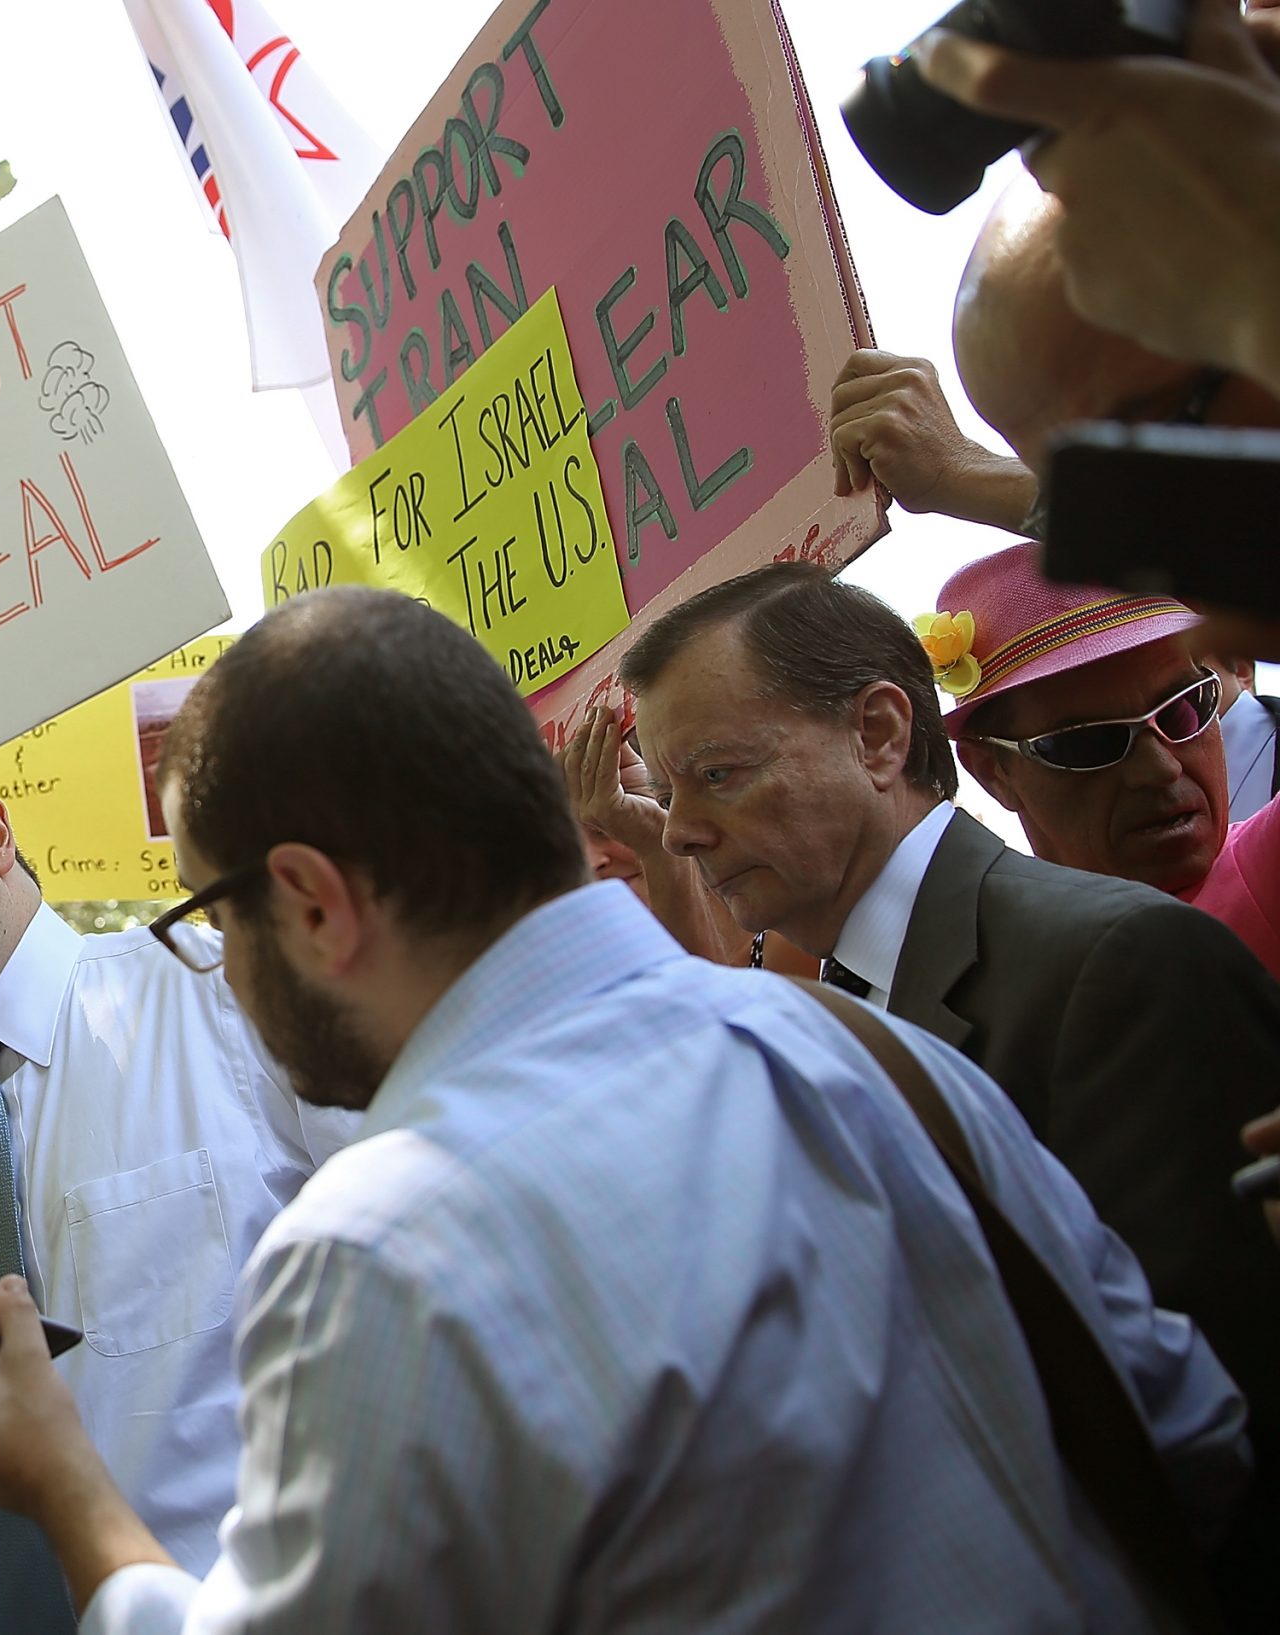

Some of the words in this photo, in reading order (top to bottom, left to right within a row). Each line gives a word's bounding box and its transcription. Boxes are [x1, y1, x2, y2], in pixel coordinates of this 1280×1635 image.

[327, 0, 565, 383] SUPPORT
[588, 132, 790, 437] EAR
[271, 540, 332, 606] BAD
[369, 467, 432, 565] FOR
[447, 536, 528, 639] THE
[533, 455, 607, 588] U.S.
[623, 395, 754, 562] AL
[47, 845, 121, 875] Crime:
